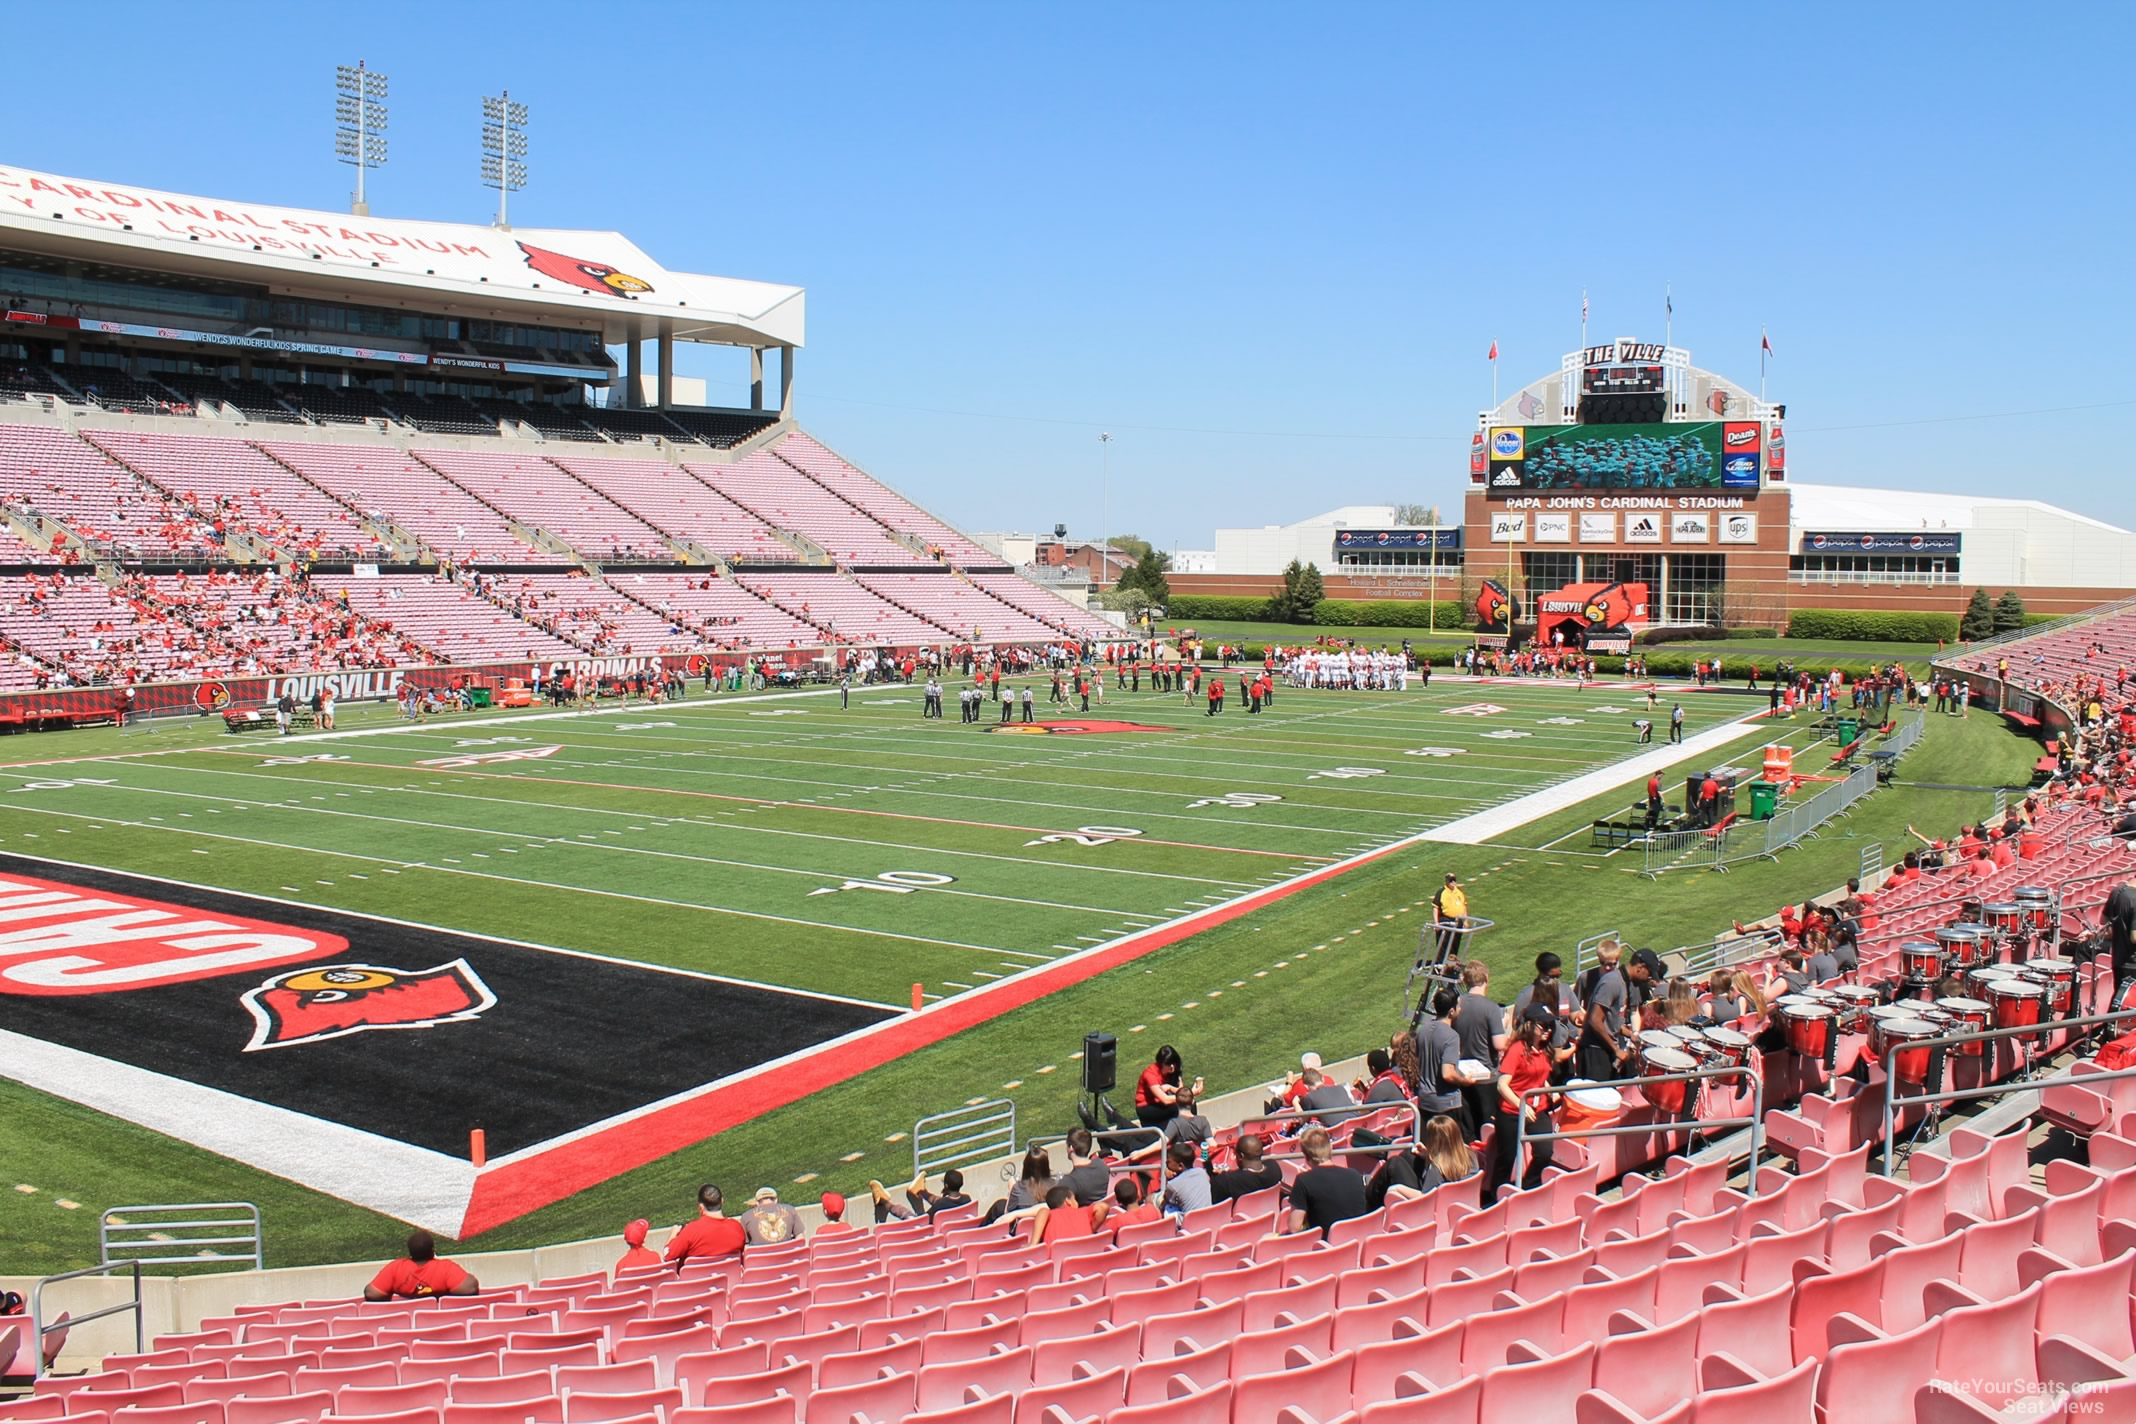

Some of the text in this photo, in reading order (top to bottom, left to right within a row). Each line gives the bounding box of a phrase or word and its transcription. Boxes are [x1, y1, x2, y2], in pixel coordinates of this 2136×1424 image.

[74, 207, 131, 225] OF
[157, 220, 400, 264] LOUISVILLE
[281, 219, 492, 259] STADIUM
[194, 332, 229, 344] WENDY'S
[229, 336, 273, 349] WONDERFUL
[274, 341, 291, 350] KIDS
[292, 342, 319, 353] SPRING
[320, 346, 342, 354] GAME
[1585, 344, 1664, 365] THE VILLE
[432, 357, 501, 370] WENDY'S WONDERFUL KIDS
[1496, 435, 1519, 452] Kroger
[1728, 429, 1757, 444] Dean's
[1492, 477, 1521, 486] adidas
[1506, 496, 1743, 508] PAPA JOHN'S CARDINAL STADIUM
[1495, 520, 1524, 534] Bud
[1549, 523, 1566, 531] PNC
[1630, 529, 1657, 537] adidas
[1730, 523, 1747, 535] ups
[1352, 535, 1374, 543] pepsi
[1389, 535, 1411, 543] pepsi
[1828, 537, 1954, 548] pepsi pepsi pepsi
[1394, 589, 1424, 598] Complex
[1587, 639, 1630, 650] LOUISVILLE
[549, 656, 662, 680] CARDINALS
[267, 671, 404, 705] LOUISVILLE
[1196, 792, 1284, 808] 30
[1040, 825, 1145, 846] 20
[838, 871, 955, 894] 10
